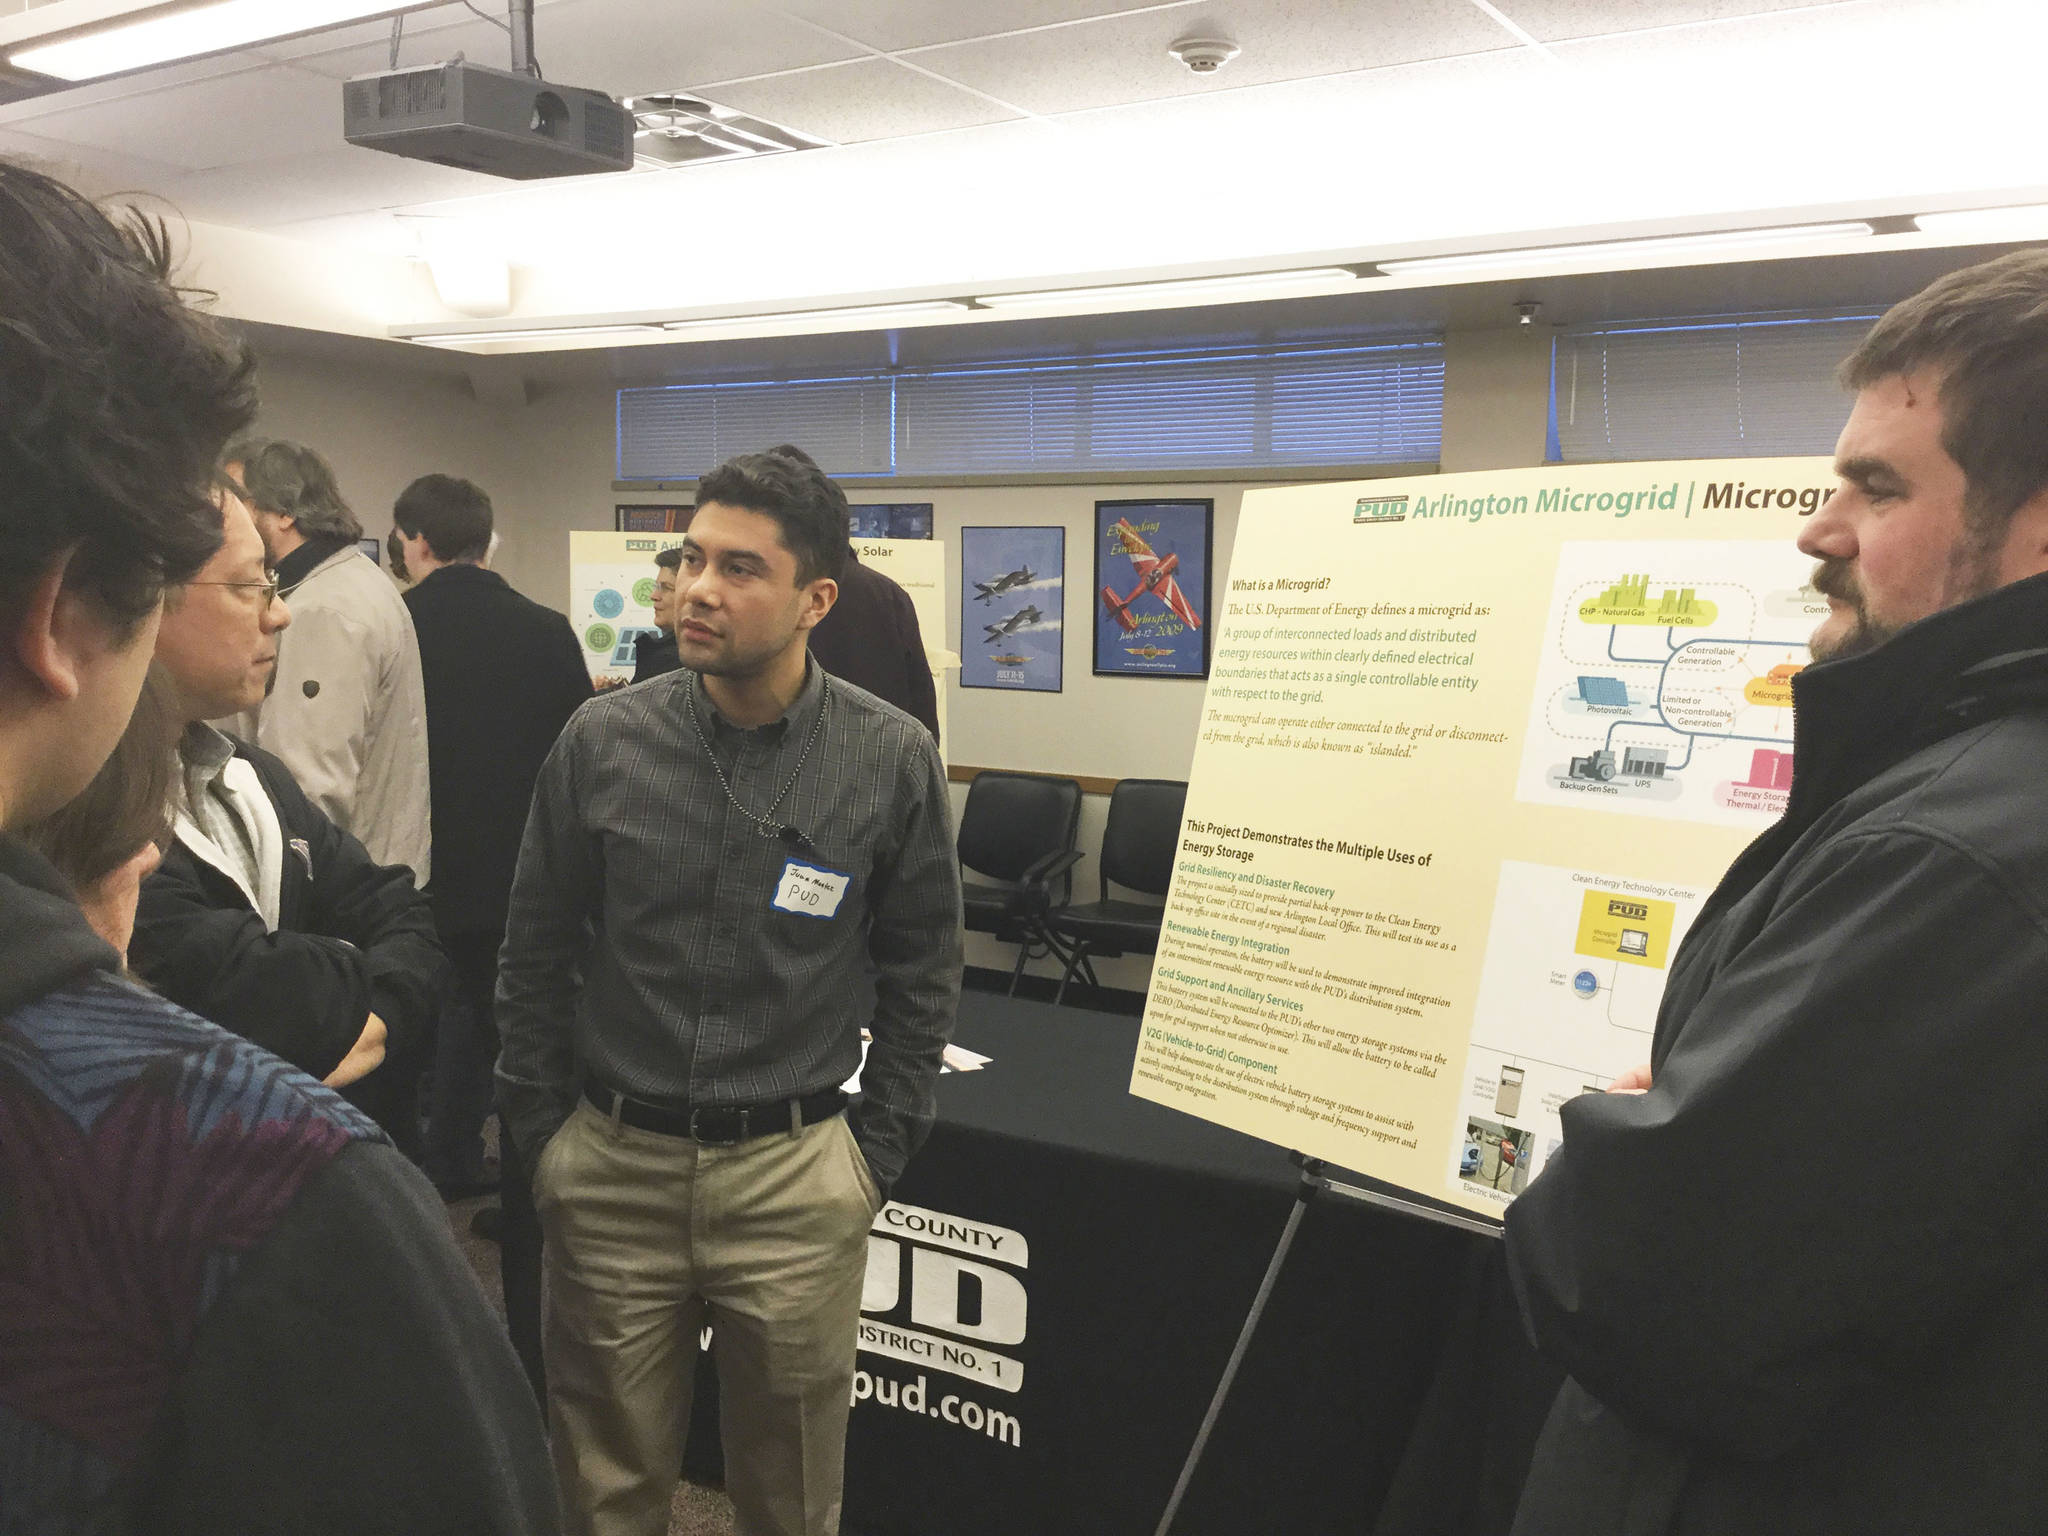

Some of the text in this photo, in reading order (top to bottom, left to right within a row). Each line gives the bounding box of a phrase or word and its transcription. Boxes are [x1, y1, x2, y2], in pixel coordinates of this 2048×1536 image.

[1411, 493, 1528, 523] Arlington
[1535, 482, 1679, 518] Microgrid
[863, 546, 894, 557] Solar
[1232, 577, 1332, 594] What is a Microgrid?
[1227, 603, 1244, 615] The
[1265, 602, 1321, 619] Department
[1321, 602, 1335, 615] of
[1334, 602, 1370, 620] Energy
[1370, 602, 1407, 616] defines
[1408, 606, 1416, 616] a
[1417, 601, 1473, 620] microgrid
[1474, 607, 1491, 616] as:
[1579, 607, 1645, 617] CHP Natural Gas
[1657, 616, 1694, 625] Fuel Cells
[1232, 629, 1262, 642] group
[1262, 626, 1275, 639] of
[1274, 627, 1352, 641] interconnected
[1352, 627, 1383, 641] loads
[1384, 628, 1408, 642] and
[1409, 628, 1477, 643] distributed
[1218, 647, 1475, 666] energy resources within clearly defined electrical
[1686, 645, 1736, 656] Controllable
[1677, 656, 1722, 666] Generation
[1214, 665, 1478, 693] boundaries that acts as a single controllable entity
[1211, 685, 1324, 706] with respect to the grid.
[1662, 695, 1691, 705] Limited
[1586, 705, 1633, 716] Photovoltaic
[1664, 706, 1733, 718] Non-controllable
[1207, 708, 1225, 722] The
[1261, 716, 1277, 726] can
[1277, 717, 1309, 731] operate
[1309, 716, 1337, 730] either
[1336, 719, 1383, 733] connected
[1382, 724, 1393, 735] to
[1394, 721, 1411, 736] the
[1409, 723, 1435, 741] grid
[1434, 728, 1448, 738] or
[1448, 725, 1509, 743] disconnect-
[1677, 717, 1723, 728] Generation
[1559, 781, 1618, 795] Backup Gen Sets
[1634, 779, 1652, 789] UPS
[1733, 788, 1761, 800] Energy
[1726, 799, 1760, 810] Thermal
[1182, 839, 1255, 864] Energy Storage
[1186, 819, 1433, 867] This Project Demonstrates the Multiple Uses of
[1178, 860, 1336, 901] Grid Resiliency and Disaster Recovery
[1572, 873, 1696, 900] Clean Energy Technology Center
[787, 884, 820, 906] PUD
[1374, 911, 1441, 936] the Clean Energy
[1166, 919, 1290, 956] Renewable Energy Integration
[1364, 924, 1457, 952] This will test its use as a
[1157, 966, 1304, 1013] Grid Support and Ancillary Services
[1368, 980, 1451, 1008] improved integration
[1146, 1026, 1163, 1041] V2G
[1227, 1050, 1279, 1075] Component
[1463, 1182, 1487, 1198] Electric
[884, 1207, 1004, 1251] COUNTY
[943, 1347, 982, 1372] NO.
[992, 1360, 1002, 1378] 1
[850, 1368, 1021, 1448] pud.com
